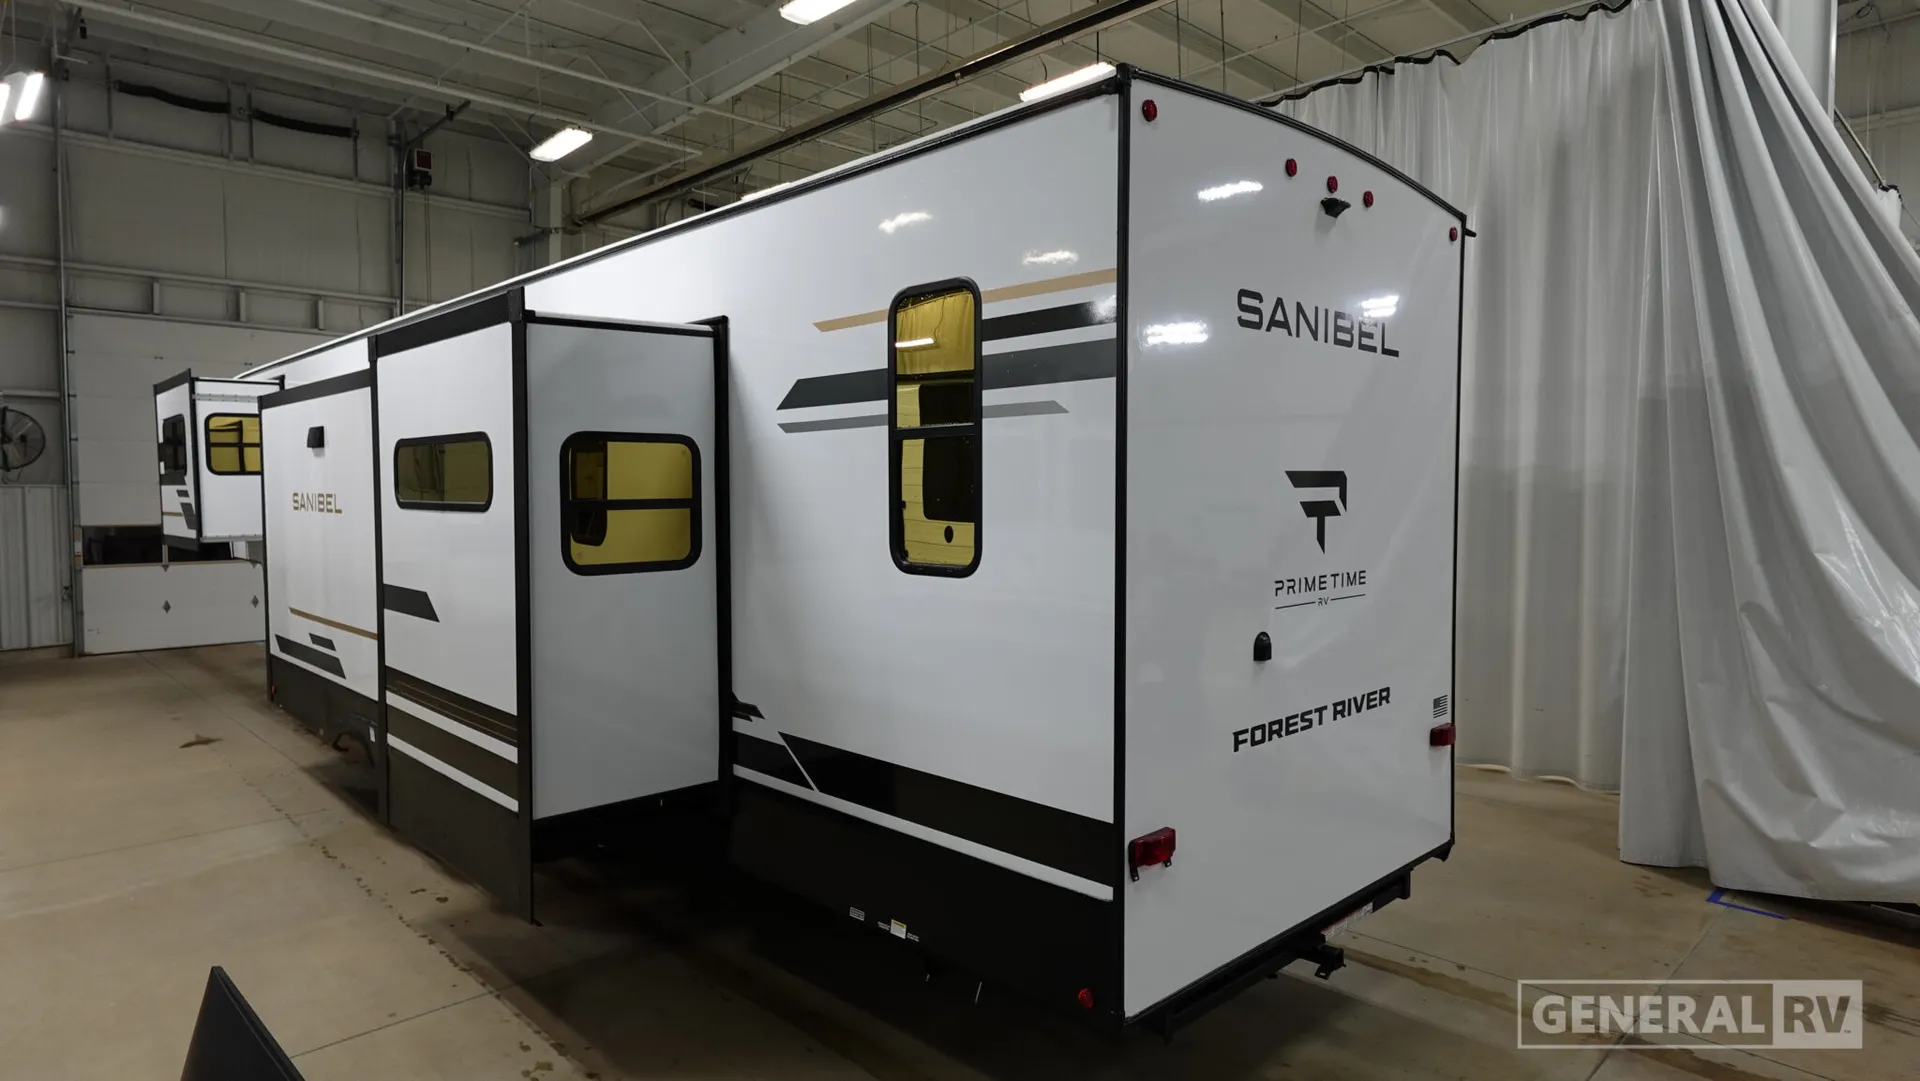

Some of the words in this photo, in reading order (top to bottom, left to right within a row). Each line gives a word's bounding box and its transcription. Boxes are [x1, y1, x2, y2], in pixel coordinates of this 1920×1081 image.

[1237, 288, 1400, 358] SANIBEL
[292, 492, 342, 514] SANIBEL
[1232, 705, 1328, 753] FOREST
[1332, 686, 1391, 721] RIVER
